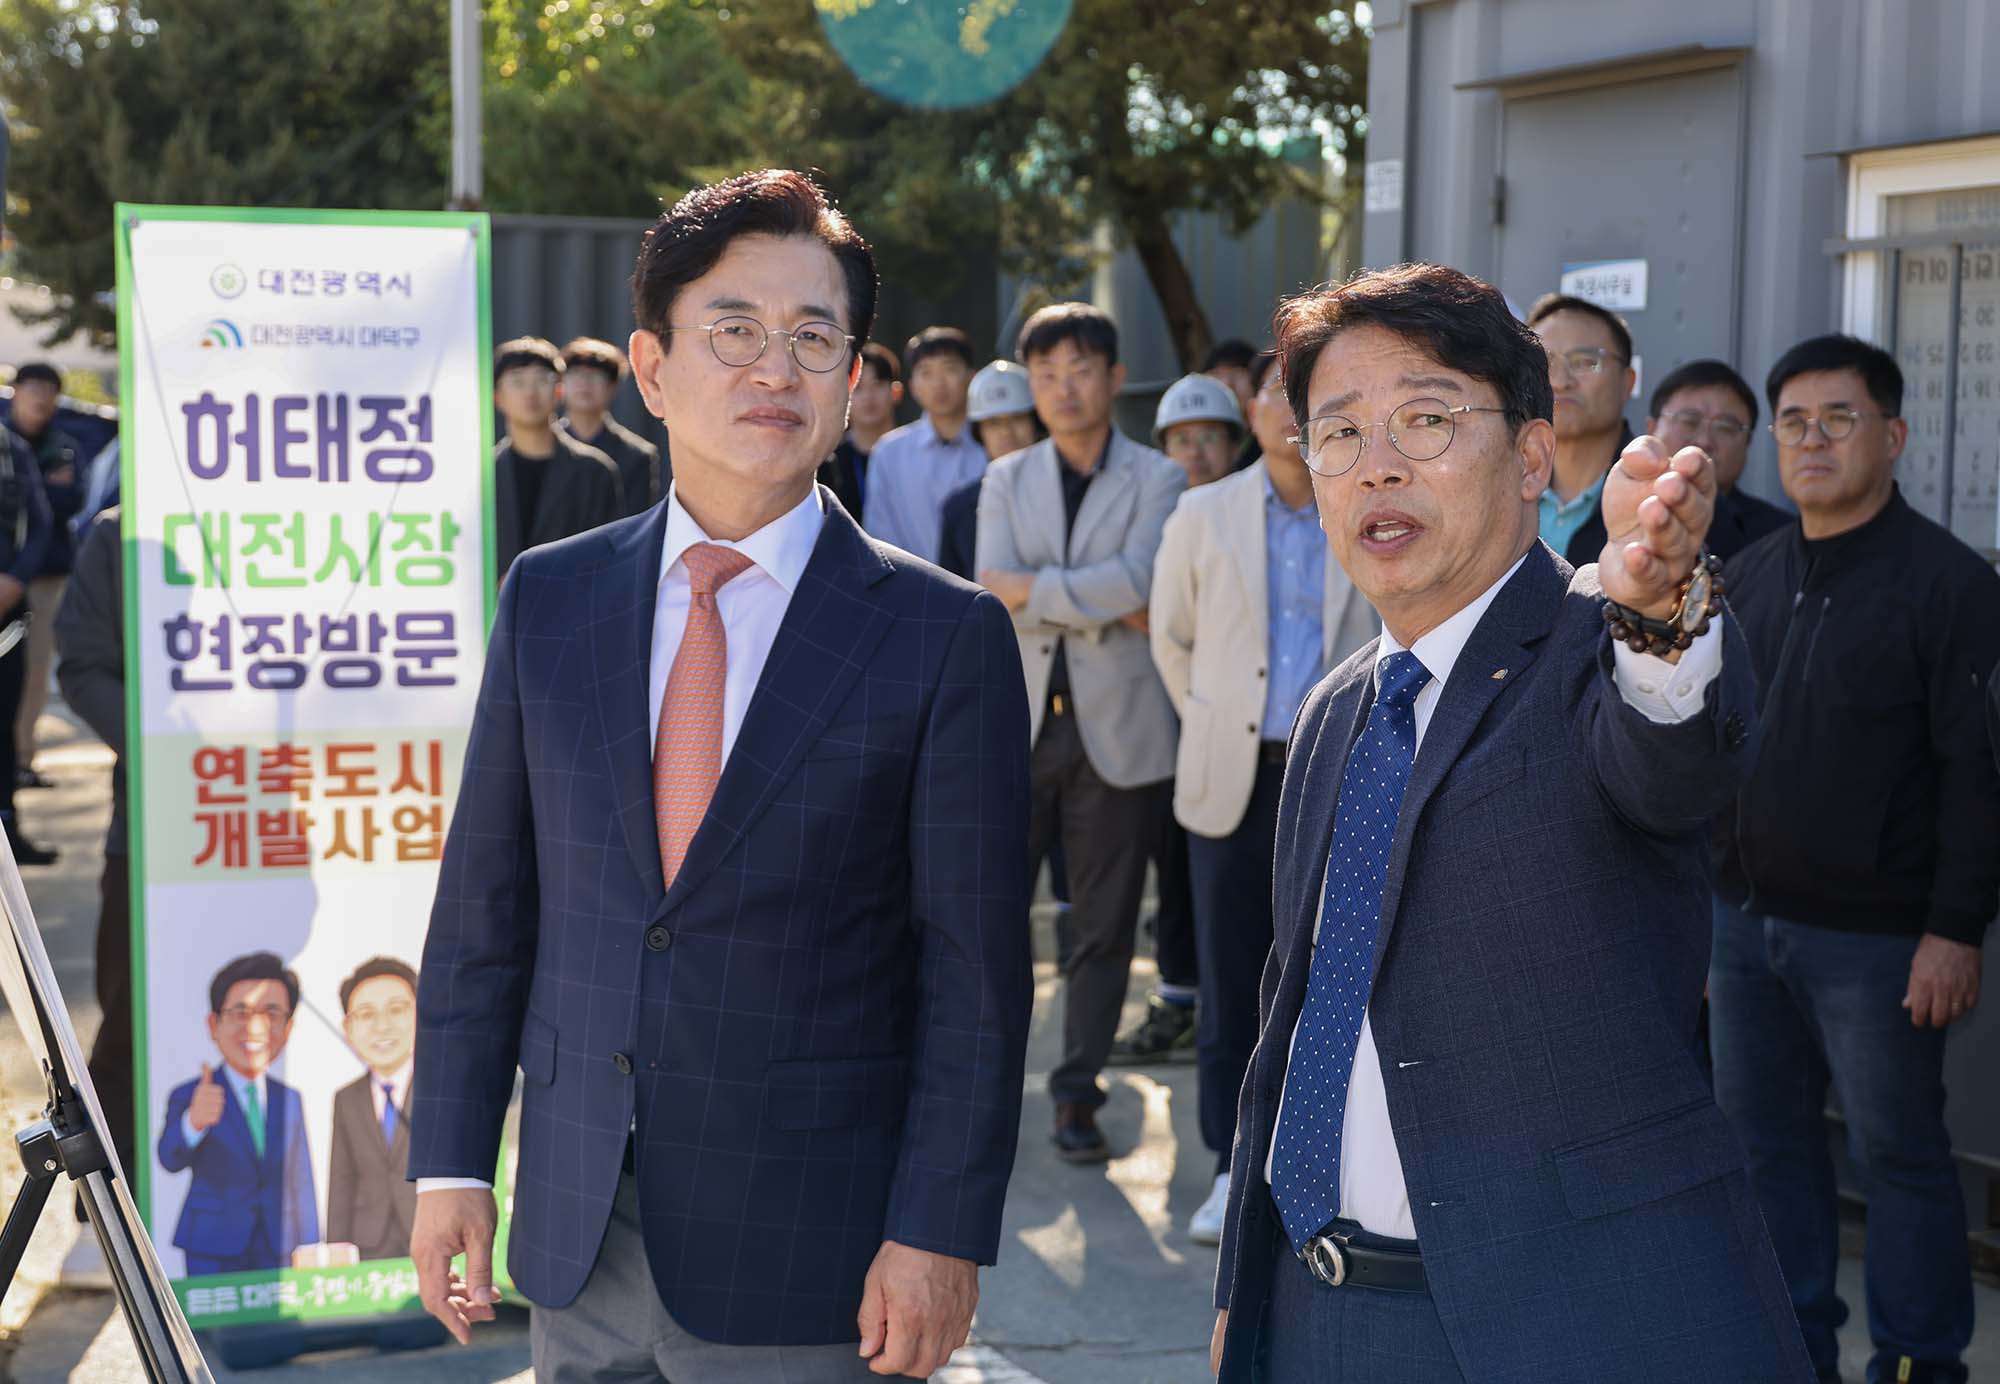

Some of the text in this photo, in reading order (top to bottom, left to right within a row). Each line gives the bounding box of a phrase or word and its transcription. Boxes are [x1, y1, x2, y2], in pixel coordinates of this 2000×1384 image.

[257, 268, 412, 297] 대전광역시
[252, 324, 421, 347] 대전광역시 대덕구
[181, 392, 435, 483] 허태정
[163, 511, 462, 589] 대전시장
[162, 611, 459, 691] 현장방문
[191, 739, 443, 805] 연축도시
[192, 803, 445, 870] 개발사업
